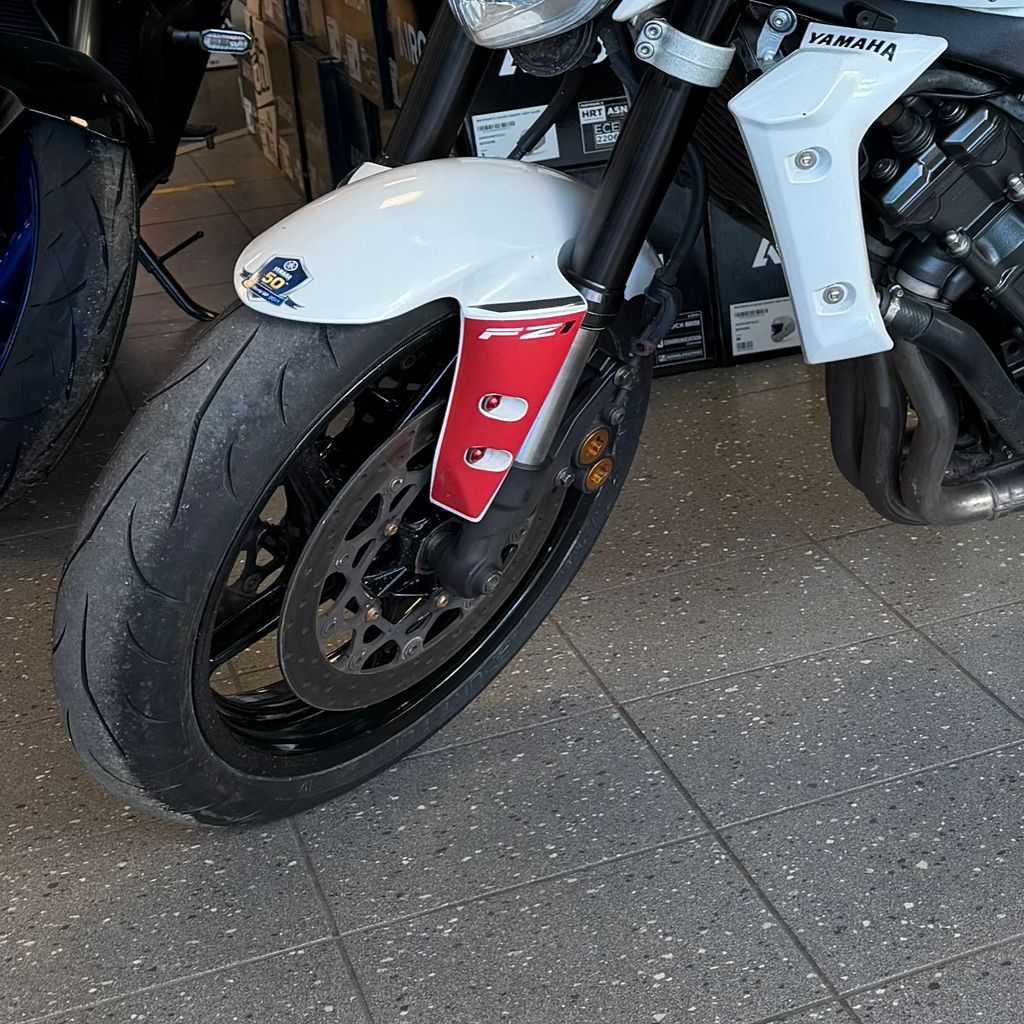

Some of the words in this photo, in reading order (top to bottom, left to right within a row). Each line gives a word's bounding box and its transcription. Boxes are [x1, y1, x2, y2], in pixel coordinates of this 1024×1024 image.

[808, 32, 897, 62] YAMAHA
[582, 108, 603, 119] HRT
[607, 105, 628, 116] ASN
[595, 122, 620, 134] ECE
[478, 320, 576, 340] FZ1
